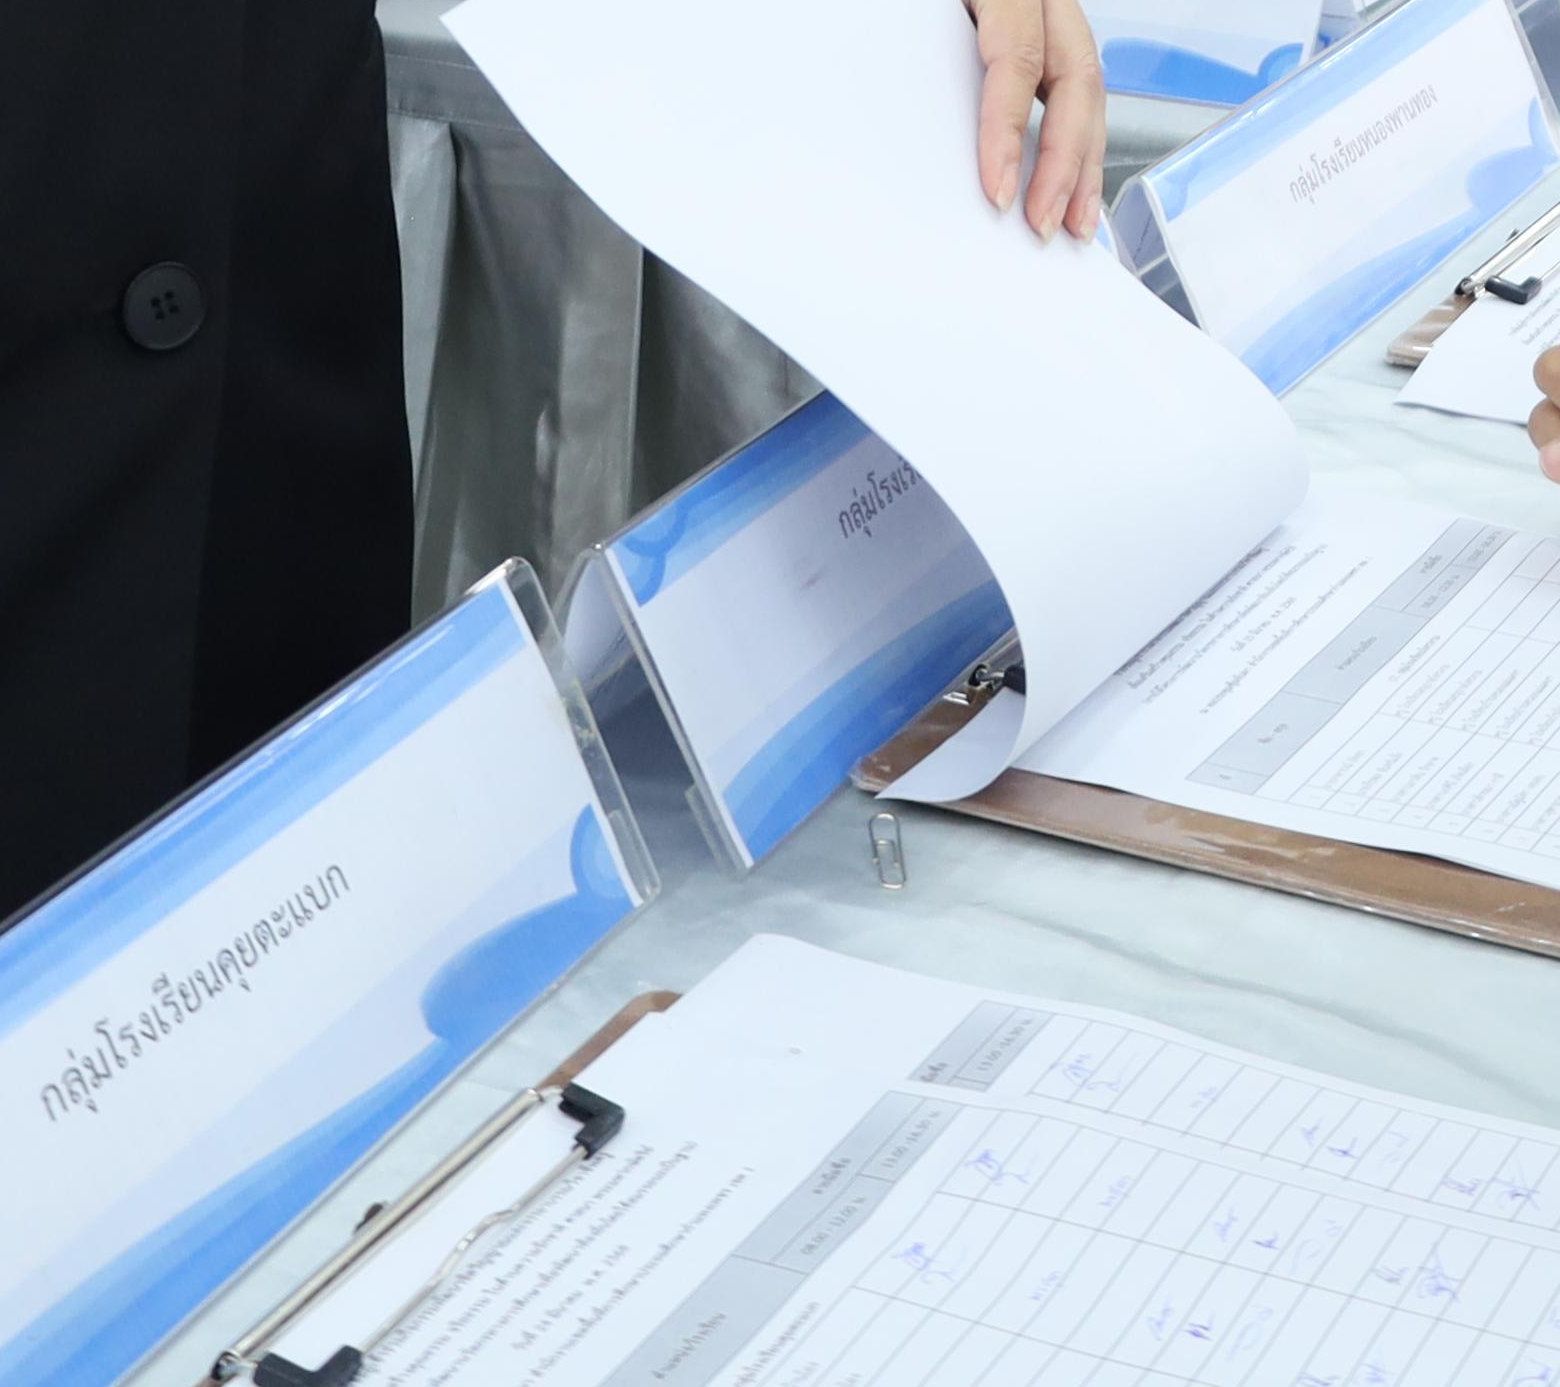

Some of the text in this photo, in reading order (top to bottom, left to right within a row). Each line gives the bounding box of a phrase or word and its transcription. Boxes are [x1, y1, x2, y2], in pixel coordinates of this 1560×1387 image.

[39, 861, 351, 1123] กลุ่มโรงเรียนคุยตะแบก
